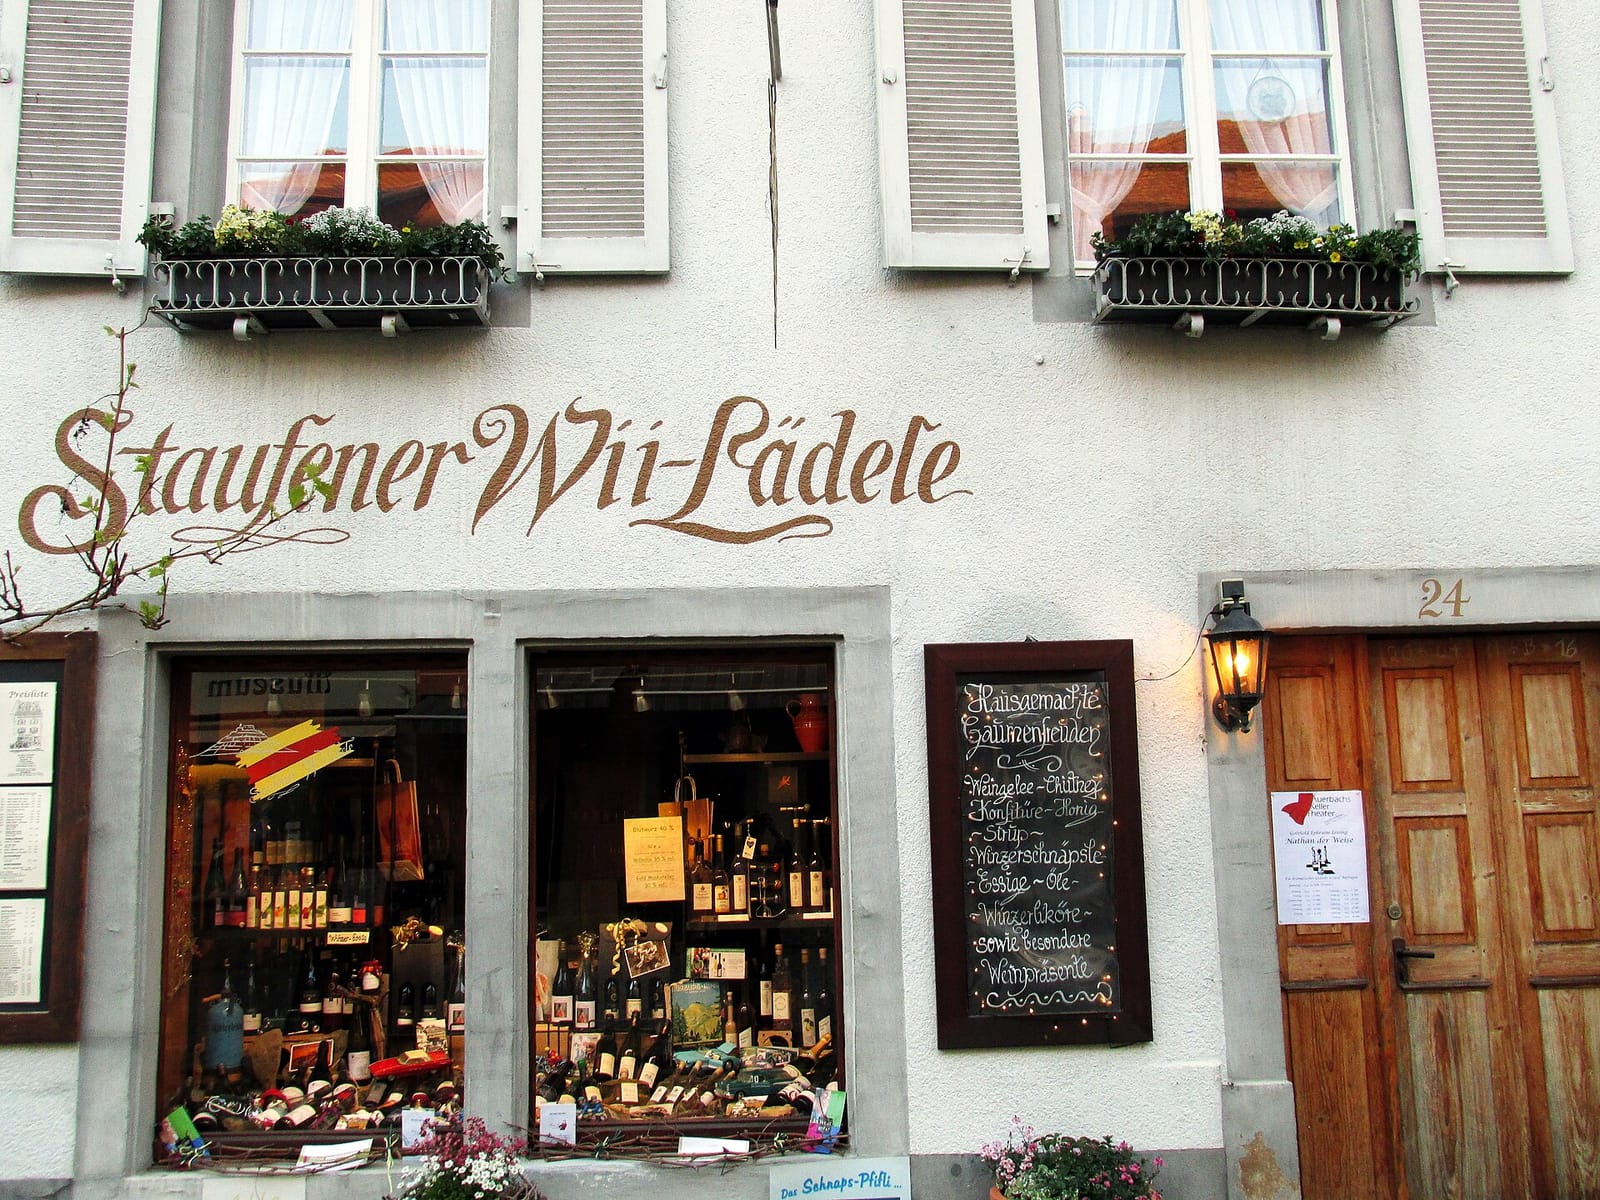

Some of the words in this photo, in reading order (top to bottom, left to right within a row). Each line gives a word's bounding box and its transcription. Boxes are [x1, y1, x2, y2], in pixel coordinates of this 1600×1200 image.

[18, 407, 475, 555] Staufener
[471, 396, 974, 545] Wii-Lädele
[1418, 578, 1472, 619] 24
[963, 682, 1103, 719] Hausgemachte
[960, 716, 1102, 761] Gaumenfreuden
[964, 773, 1035, 805] Weingelee
[1043, 770, 1103, 800] Chutney
[968, 799, 1045, 826] Konfitüre
[1053, 798, 1105, 828] Honig
[983, 825, 1029, 848] Sirup
[969, 838, 1104, 874] Winzerschnäpsle
[976, 867, 1031, 907] Essige
[1046, 867, 1072, 891] Öle
[977, 899, 1083, 935] Winzerliköre
[975, 932, 1020, 954] sowie
[1021, 927, 1092, 950] besondere
[980, 953, 1094, 997] Weinpräsente
[781, 1188, 798, 1199] Das
